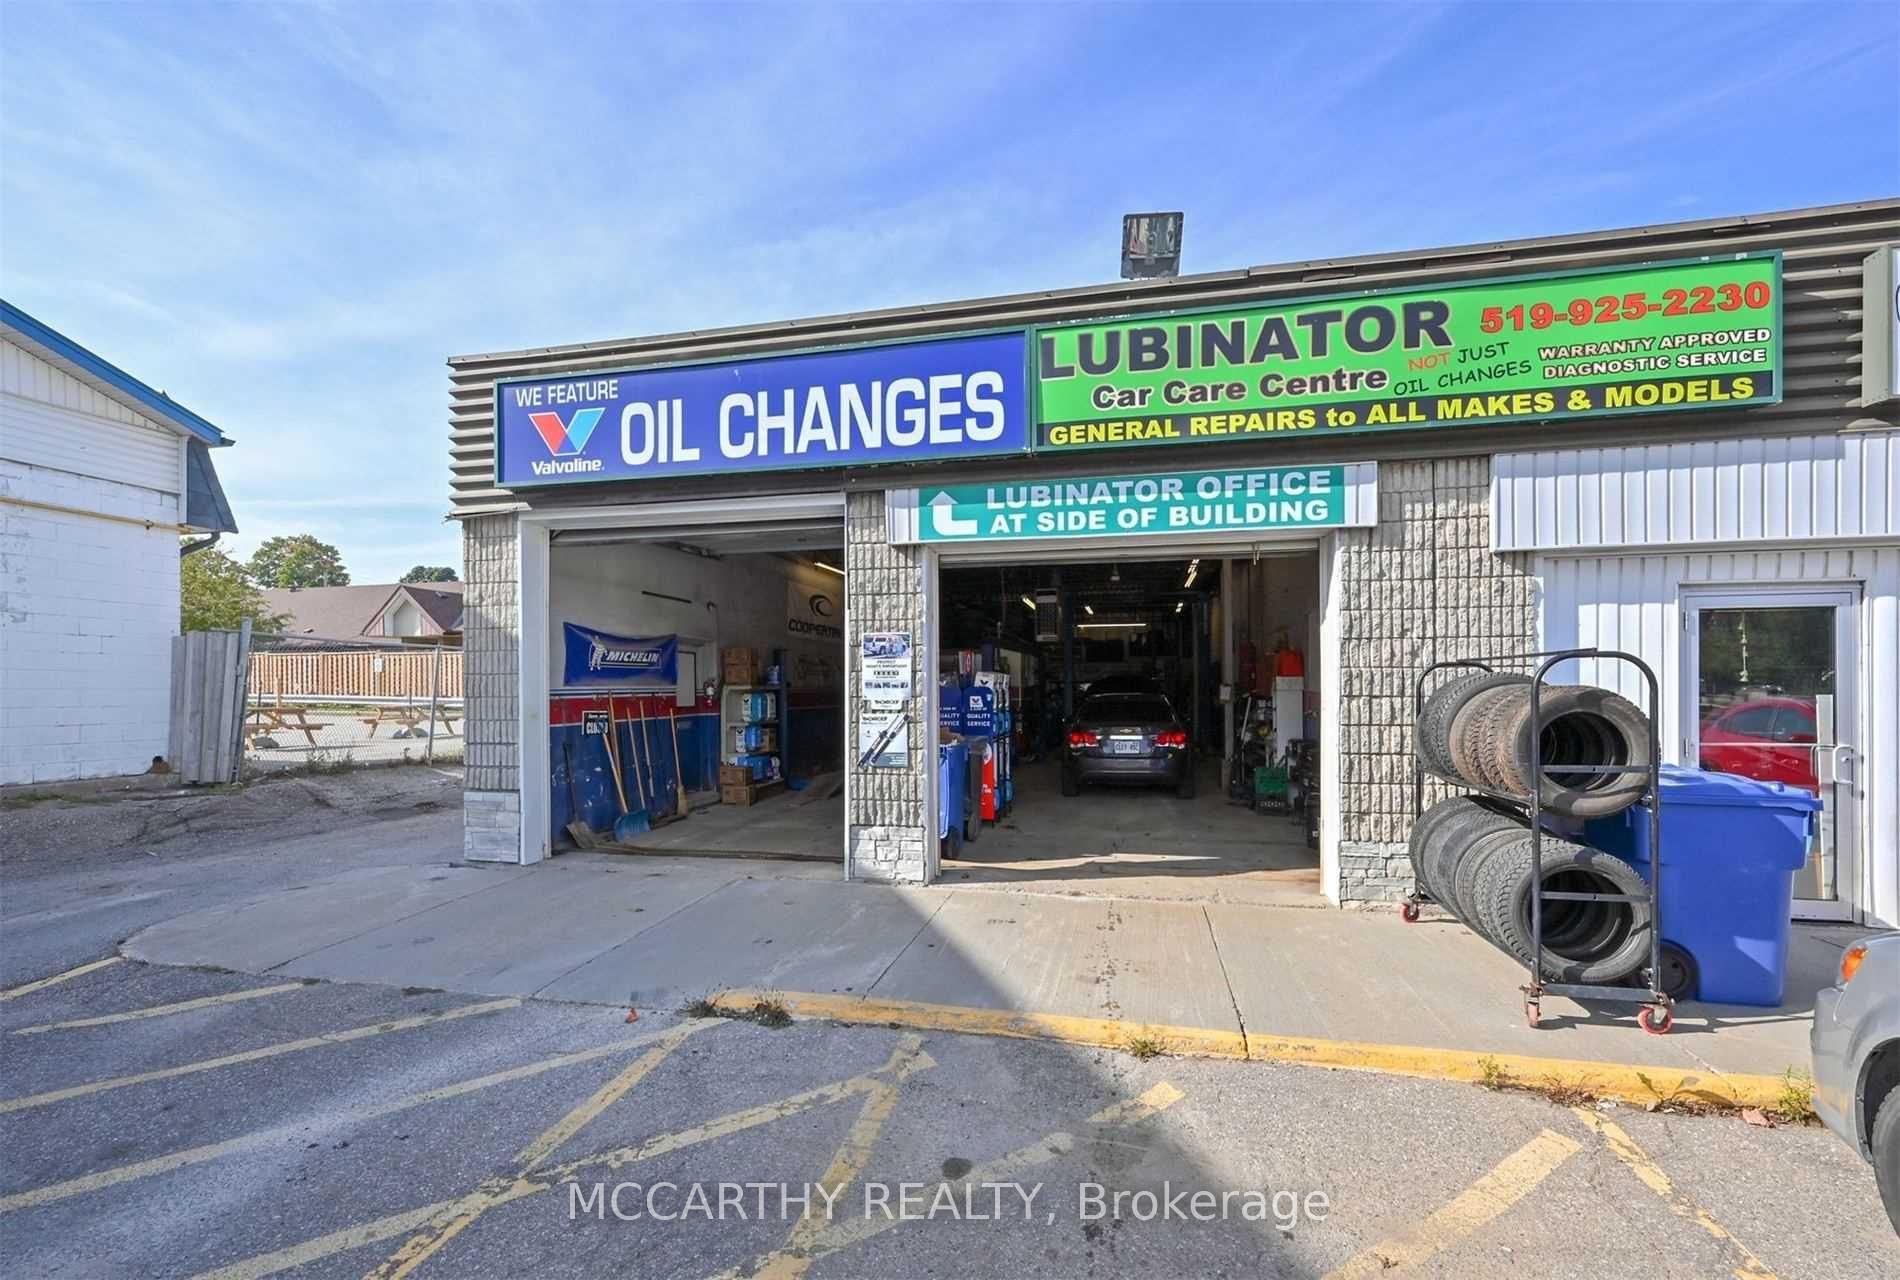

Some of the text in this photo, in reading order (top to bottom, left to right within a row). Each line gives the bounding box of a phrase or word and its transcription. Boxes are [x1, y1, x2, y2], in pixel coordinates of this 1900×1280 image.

[1480, 281, 1770, 334] 519-925-2230
[1039, 299, 1453, 380] LUBINATOR
[1408, 341, 1510, 372] NOT JUST
[1538, 328, 1771, 361] WARRANTY APPROVED
[1393, 359, 1532, 397] OIL CHANGES
[1543, 348, 1767, 380] DIAGNOSTIC SERVICE
[515, 380, 619, 407] WE FEATURE
[1093, 366, 1388, 410] Car Care Centre
[619, 370, 1006, 466] OIL CHANGES
[1049, 376, 1754, 445] GENERAL REPAIRS to ALL MAKES & MODELS
[531, 458, 603, 475] Valvoline
[987, 470, 1332, 507] LUBINATOR OFFICE
[990, 500, 1329, 535] AT SIDE OF BUILDING
[606, 650, 659, 663] MICHELIN
